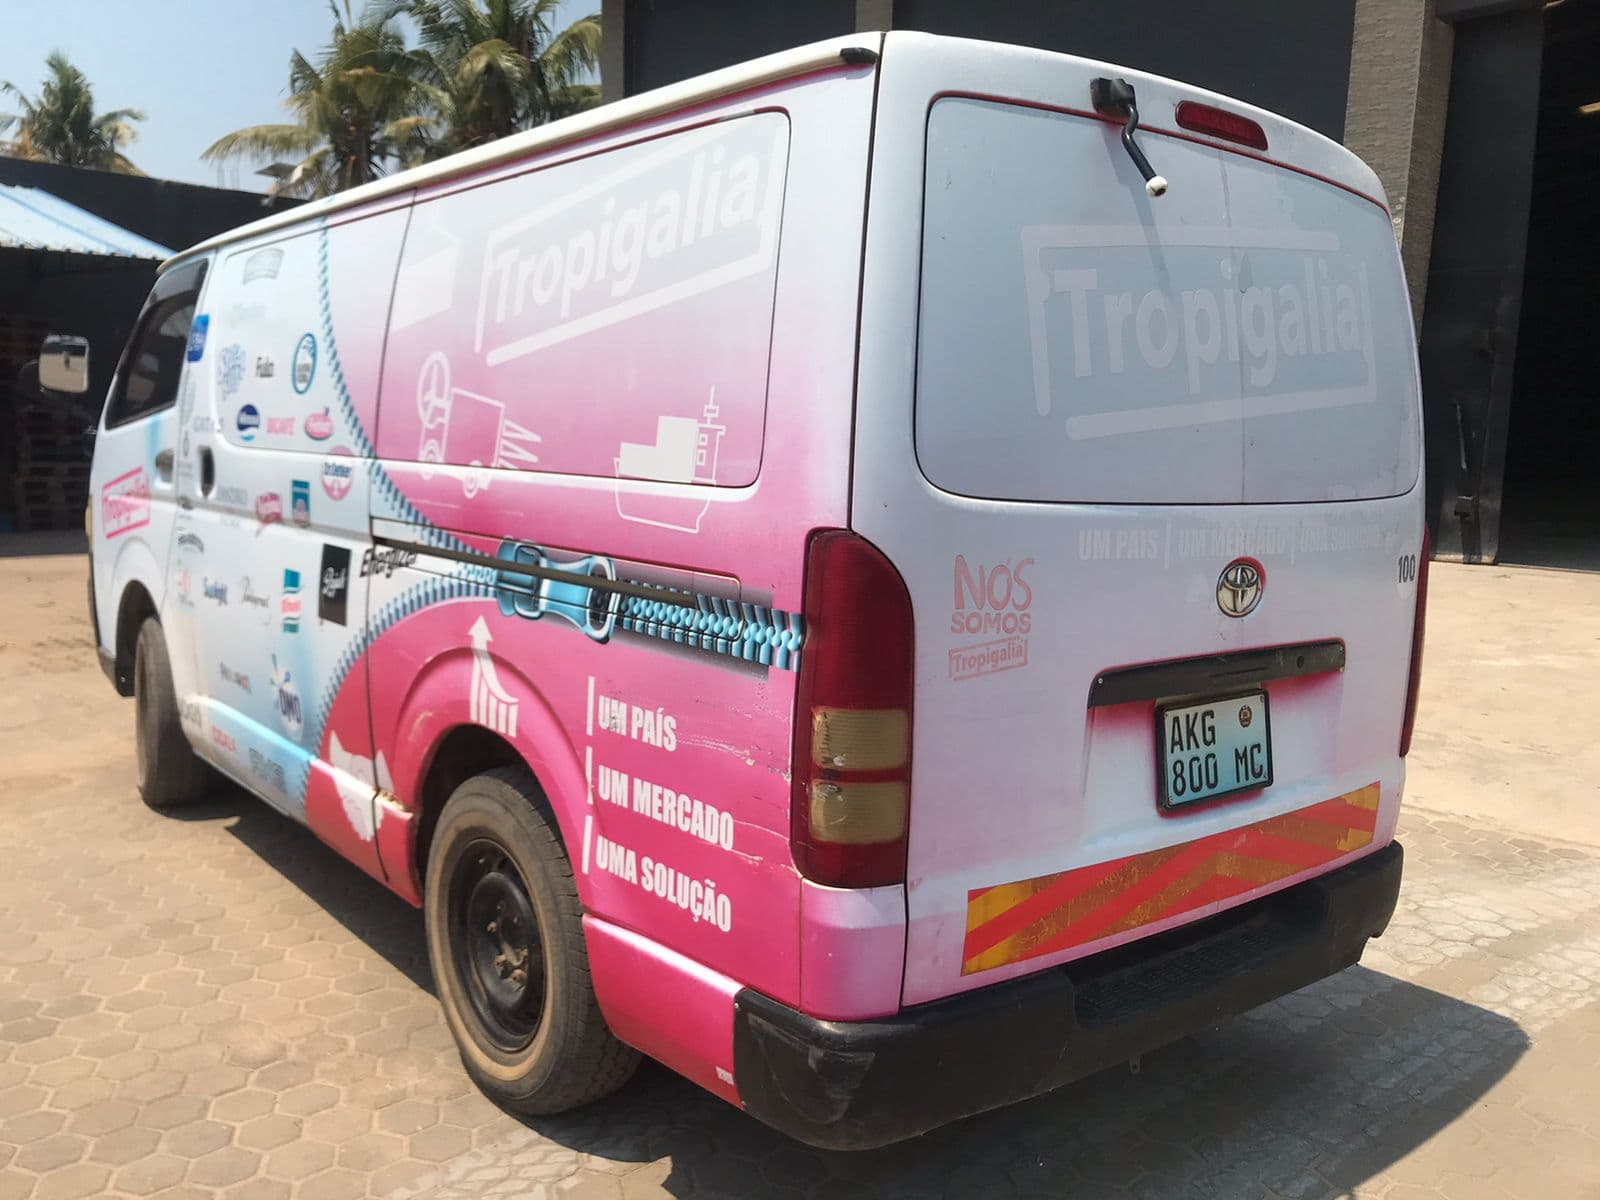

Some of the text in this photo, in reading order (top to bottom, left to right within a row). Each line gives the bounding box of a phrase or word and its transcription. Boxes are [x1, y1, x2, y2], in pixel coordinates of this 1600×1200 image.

[495, 144, 760, 323] Tropigalia
[1053, 255, 1361, 395] Tropigalia
[1077, 528, 1111, 561] UM
[1397, 554, 1416, 584] 100
[951, 611, 1032, 634] SOMOS
[953, 639, 1025, 673] Tropigalia
[598, 694, 678, 753] UM PAÍS
[1170, 709, 1217, 754] AKG
[1172, 743, 1264, 797] 800 MC
[598, 764, 735, 852] UM MERCADO
[595, 834, 732, 933] UMA SOLUÇÃO
